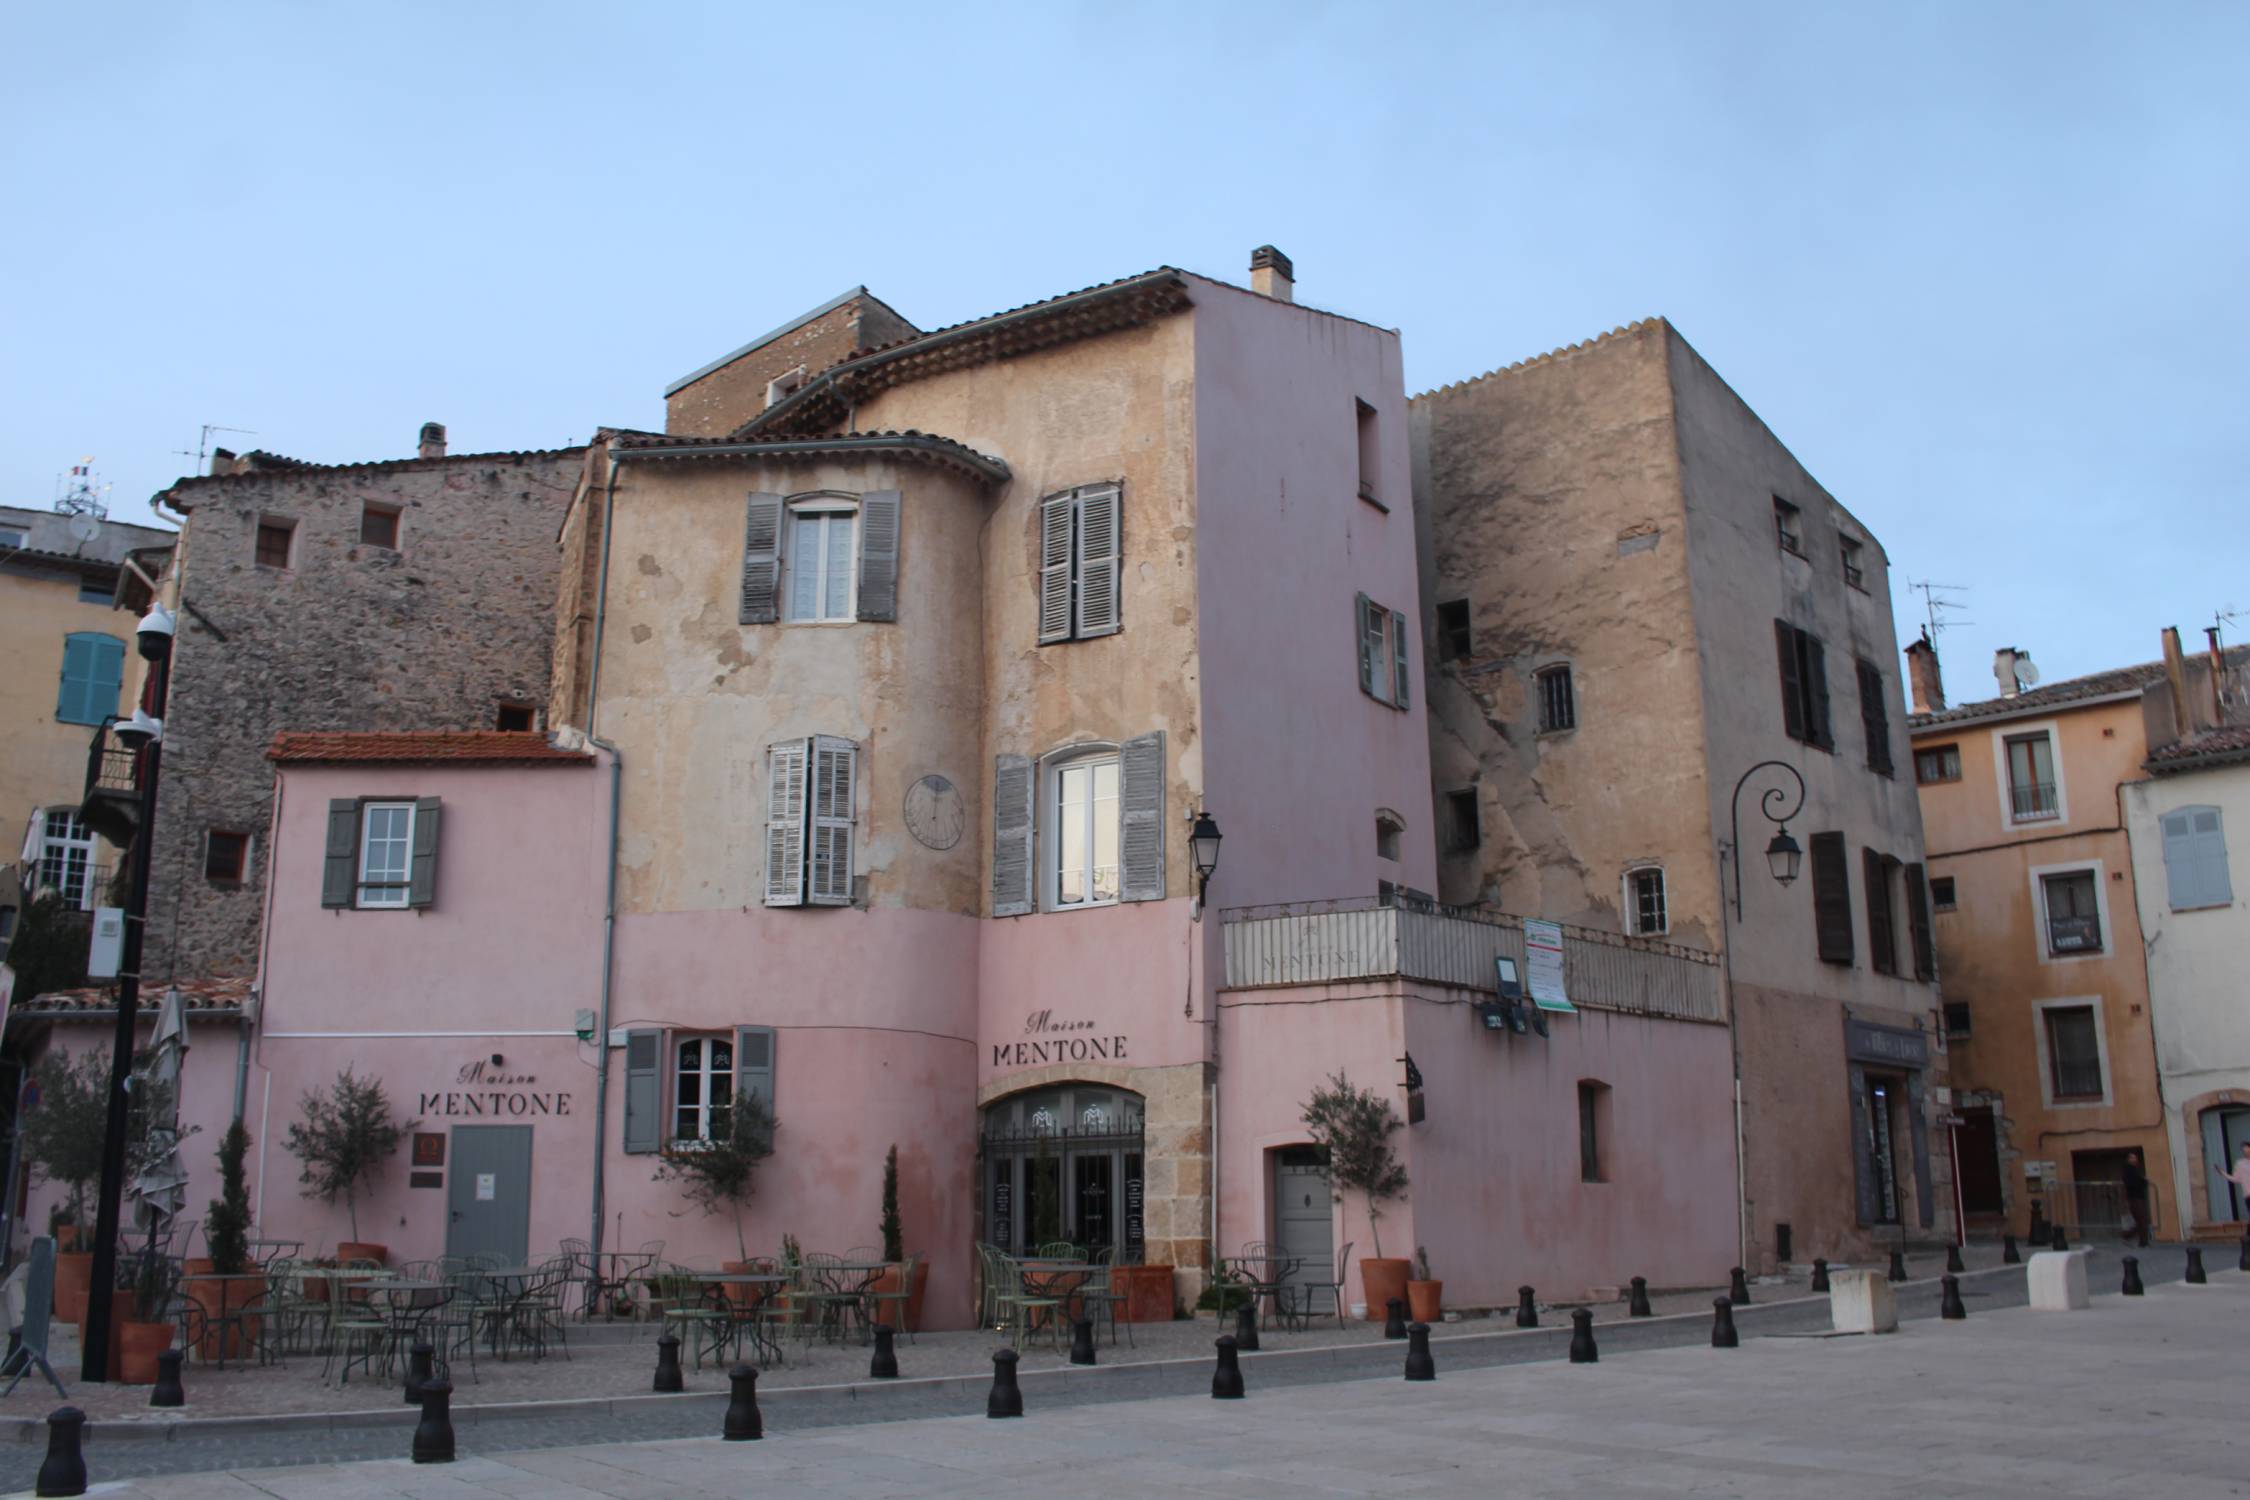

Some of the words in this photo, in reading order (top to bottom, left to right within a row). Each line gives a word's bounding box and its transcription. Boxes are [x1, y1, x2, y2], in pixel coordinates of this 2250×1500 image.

[1025, 1008, 1096, 1034] Maison
[992, 1036, 1128, 1067] MENTONE
[455, 1060, 538, 1085] Maison
[418, 1093, 572, 1116] MENTONE
